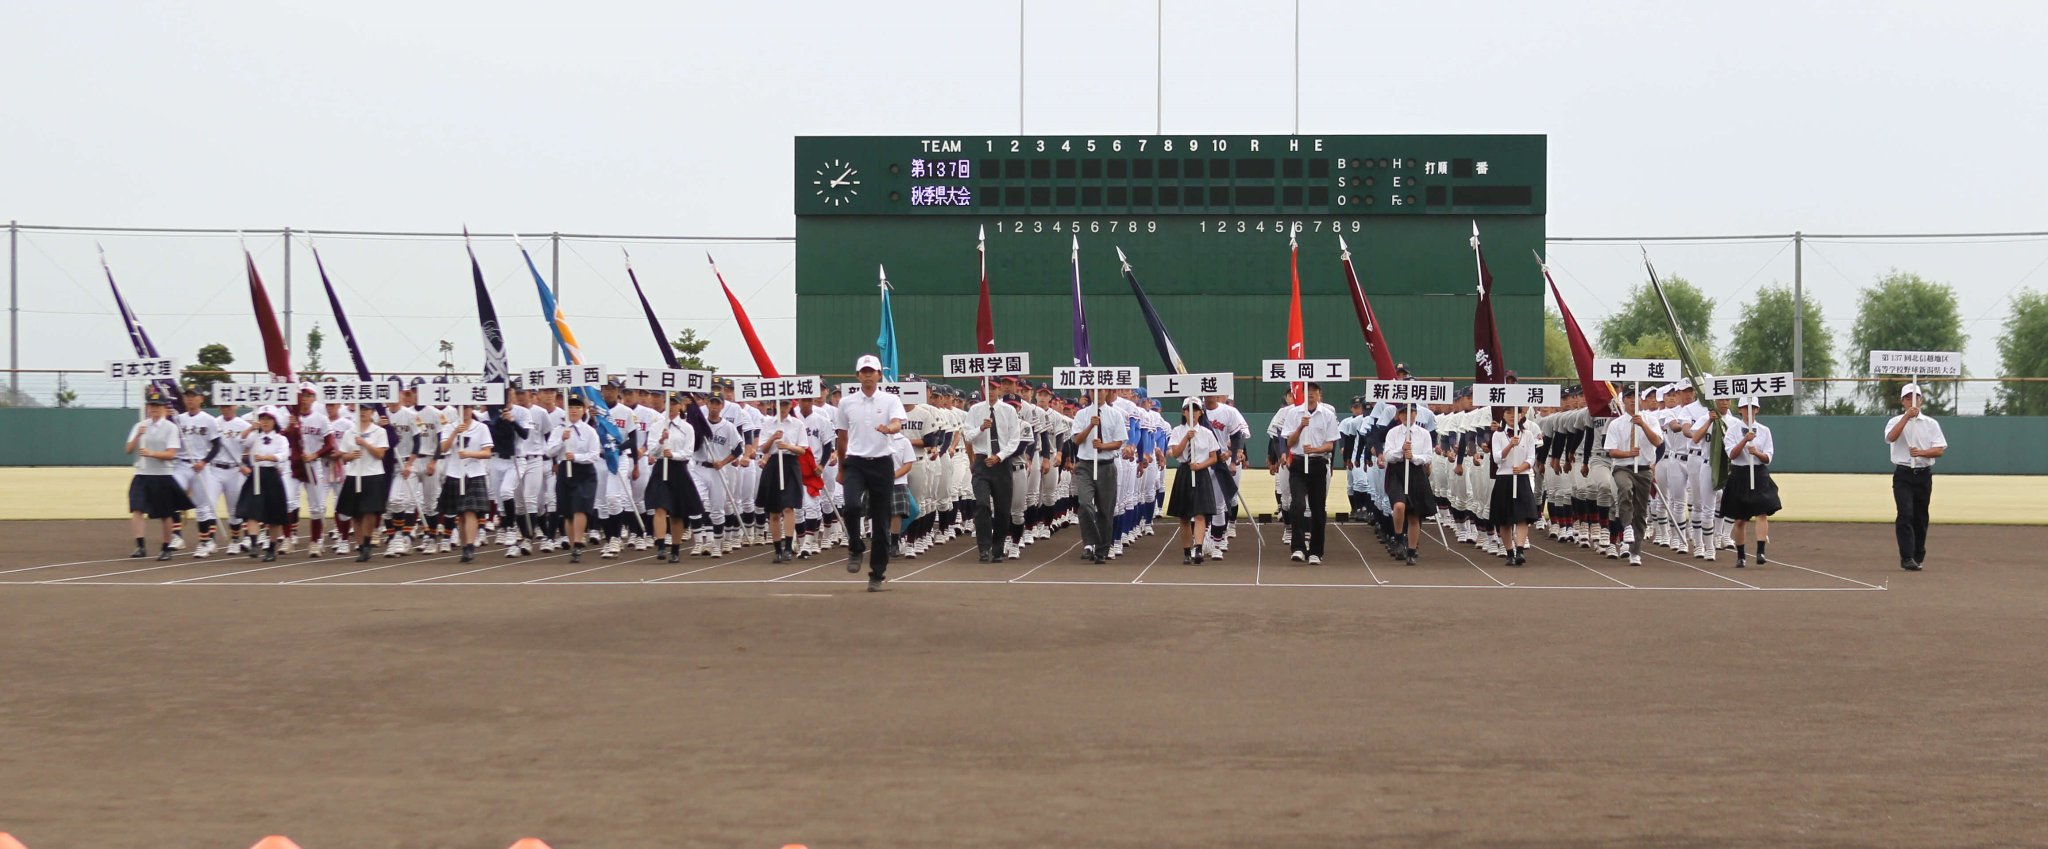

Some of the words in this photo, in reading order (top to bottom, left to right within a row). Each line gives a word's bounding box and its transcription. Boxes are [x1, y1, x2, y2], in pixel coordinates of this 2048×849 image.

[921, 139, 962, 153] TEAM
[986, 139, 992, 152] 1
[1010, 139, 1020, 152] 2
[1036, 139, 1045, 152] 3
[1061, 139, 1071, 152] 4
[1087, 139, 1096, 152] 5
[1112, 139, 1122, 152] 6
[1138, 139, 1147, 152] 7
[1163, 139, 1173, 152] 8
[1189, 139, 1198, 152] 9
[1212, 139, 1227, 152] 10
[1250, 139, 1259, 152] R
[1289, 138, 1299, 152] H
[1314, 138, 1323, 152] E
[911, 158, 970, 179] 第137回
[1337, 158, 1346, 169] B
[1392, 158, 1402, 169] H
[1424, 161, 1448, 175] 打順
[1475, 161, 1489, 175] 番
[1338, 176, 1346, 188] S
[1393, 176, 1401, 188] E
[911, 185, 971, 206] 秋季県大会
[1014, 221, 1024, 233] 2
[1033, 221, 1043, 233] 3
[1052, 221, 1062, 233] 4
[1071, 221, 1081, 233] 5
[1090, 220, 1100, 233] 6
[1109, 221, 1118, 233] 7
[1128, 221, 1138, 233] 8
[1147, 220, 1157, 233] 9
[1217, 220, 1227, 233] 2
[1237, 220, 1246, 233] 3
[1255, 221, 1265, 233] 4
[1275, 220, 1284, 233] 5
[1293, 220, 1303, 233] 6
[1313, 220, 1322, 233] 7
[1332, 220, 1341, 233] 8
[1351, 220, 1361, 233] 9
[110, 360, 173, 379] 日本文理
[950, 356, 1022, 374] 関根学園
[1269, 362, 1343, 379] 長岡工
[1873, 365, 1957, 375] 高等学校野球新潟県大会
[528, 367, 601, 386] 新潟西
[633, 370, 705, 390] 十日町
[1060, 369, 1133, 387] 加茂暁星
[219, 385, 290, 403] 村上桜ケ丘
[323, 383, 391, 402] 帝京長岡
[740, 378, 814, 398] 高田北城
[1372, 383, 1447, 401] 新潟明訓
[1712, 375, 1787, 397] 長岡大手
[900, 420, 924, 432] HIKO
